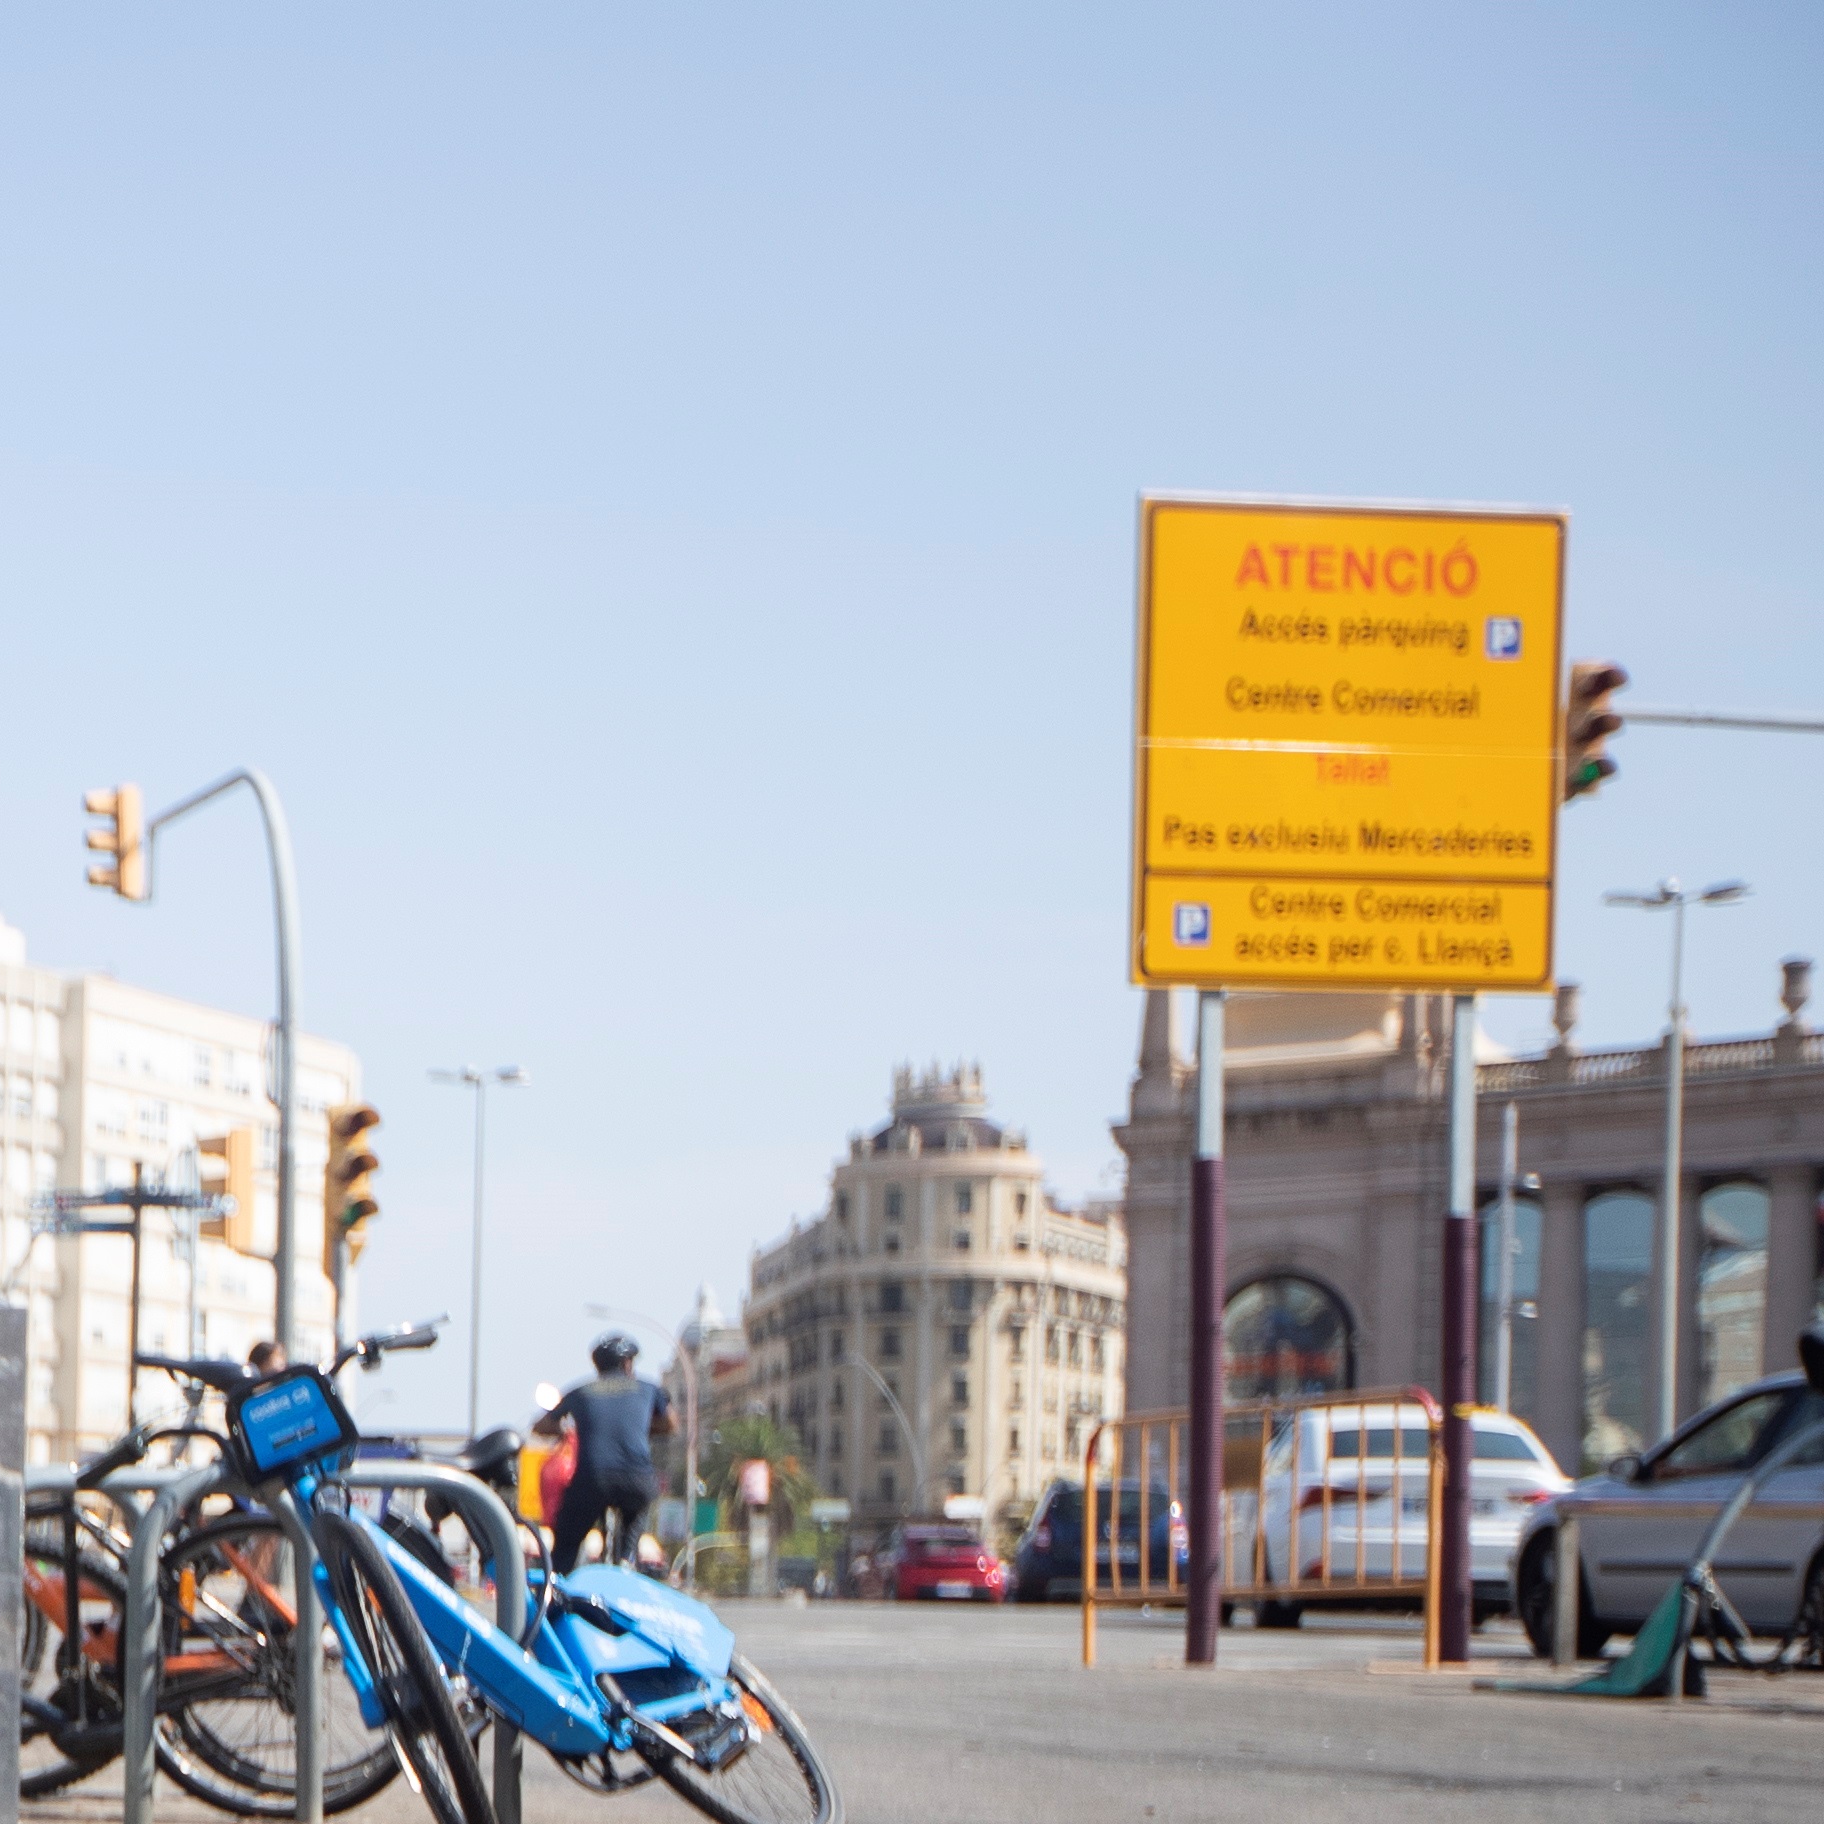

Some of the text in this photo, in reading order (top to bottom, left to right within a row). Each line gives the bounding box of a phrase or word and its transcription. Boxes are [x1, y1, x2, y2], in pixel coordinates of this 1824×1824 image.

[1235, 539, 1480, 597] ATENCIÓ
[1238, 608, 1329, 645] Accés
[1225, 676, 1481, 719] Centre Comercial
[1162, 815, 1535, 859] Pas exclusiu Mercaderies
[1249, 885, 1503, 926] Centre Comercial
[1234, 930, 1319, 962] accés
[1328, 938, 1377, 968] per
